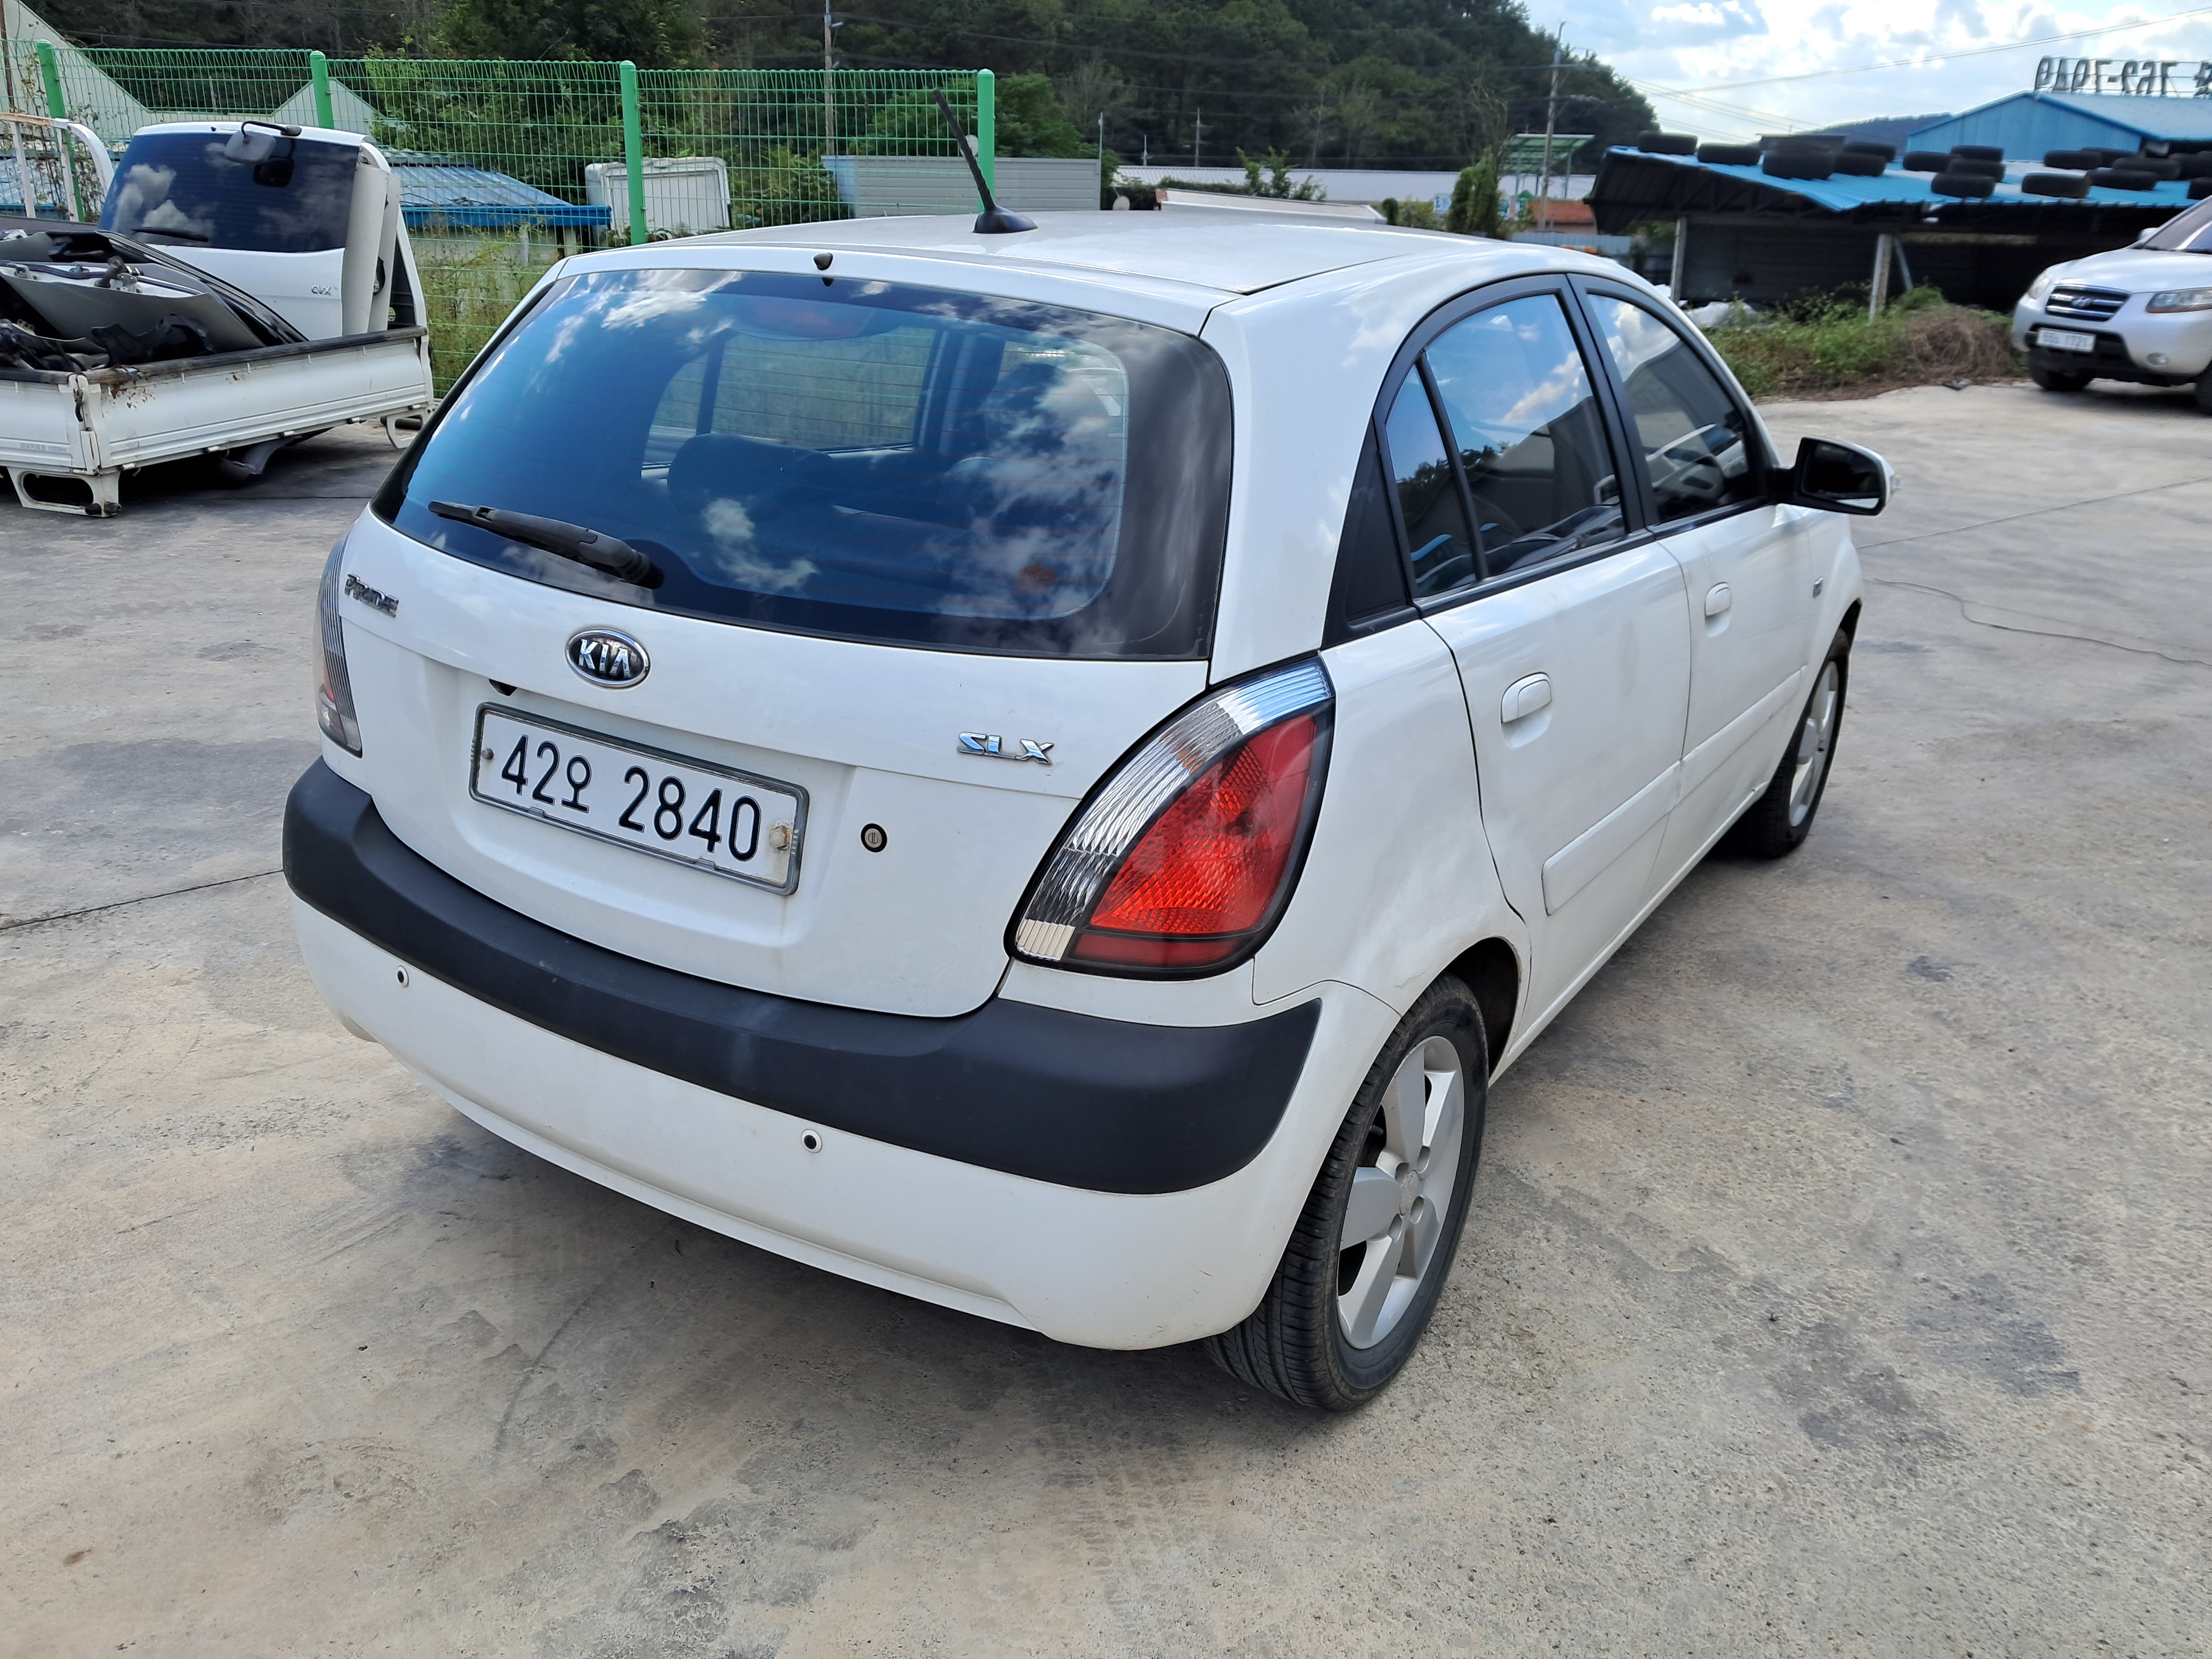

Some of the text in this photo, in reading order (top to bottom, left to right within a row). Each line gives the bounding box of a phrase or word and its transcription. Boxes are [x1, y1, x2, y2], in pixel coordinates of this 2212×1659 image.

[344, 573, 400, 618] PRIDE
[578, 639, 632, 678] KIA
[957, 731, 1054, 765] SLX
[501, 734, 761, 861] 42오 2840
